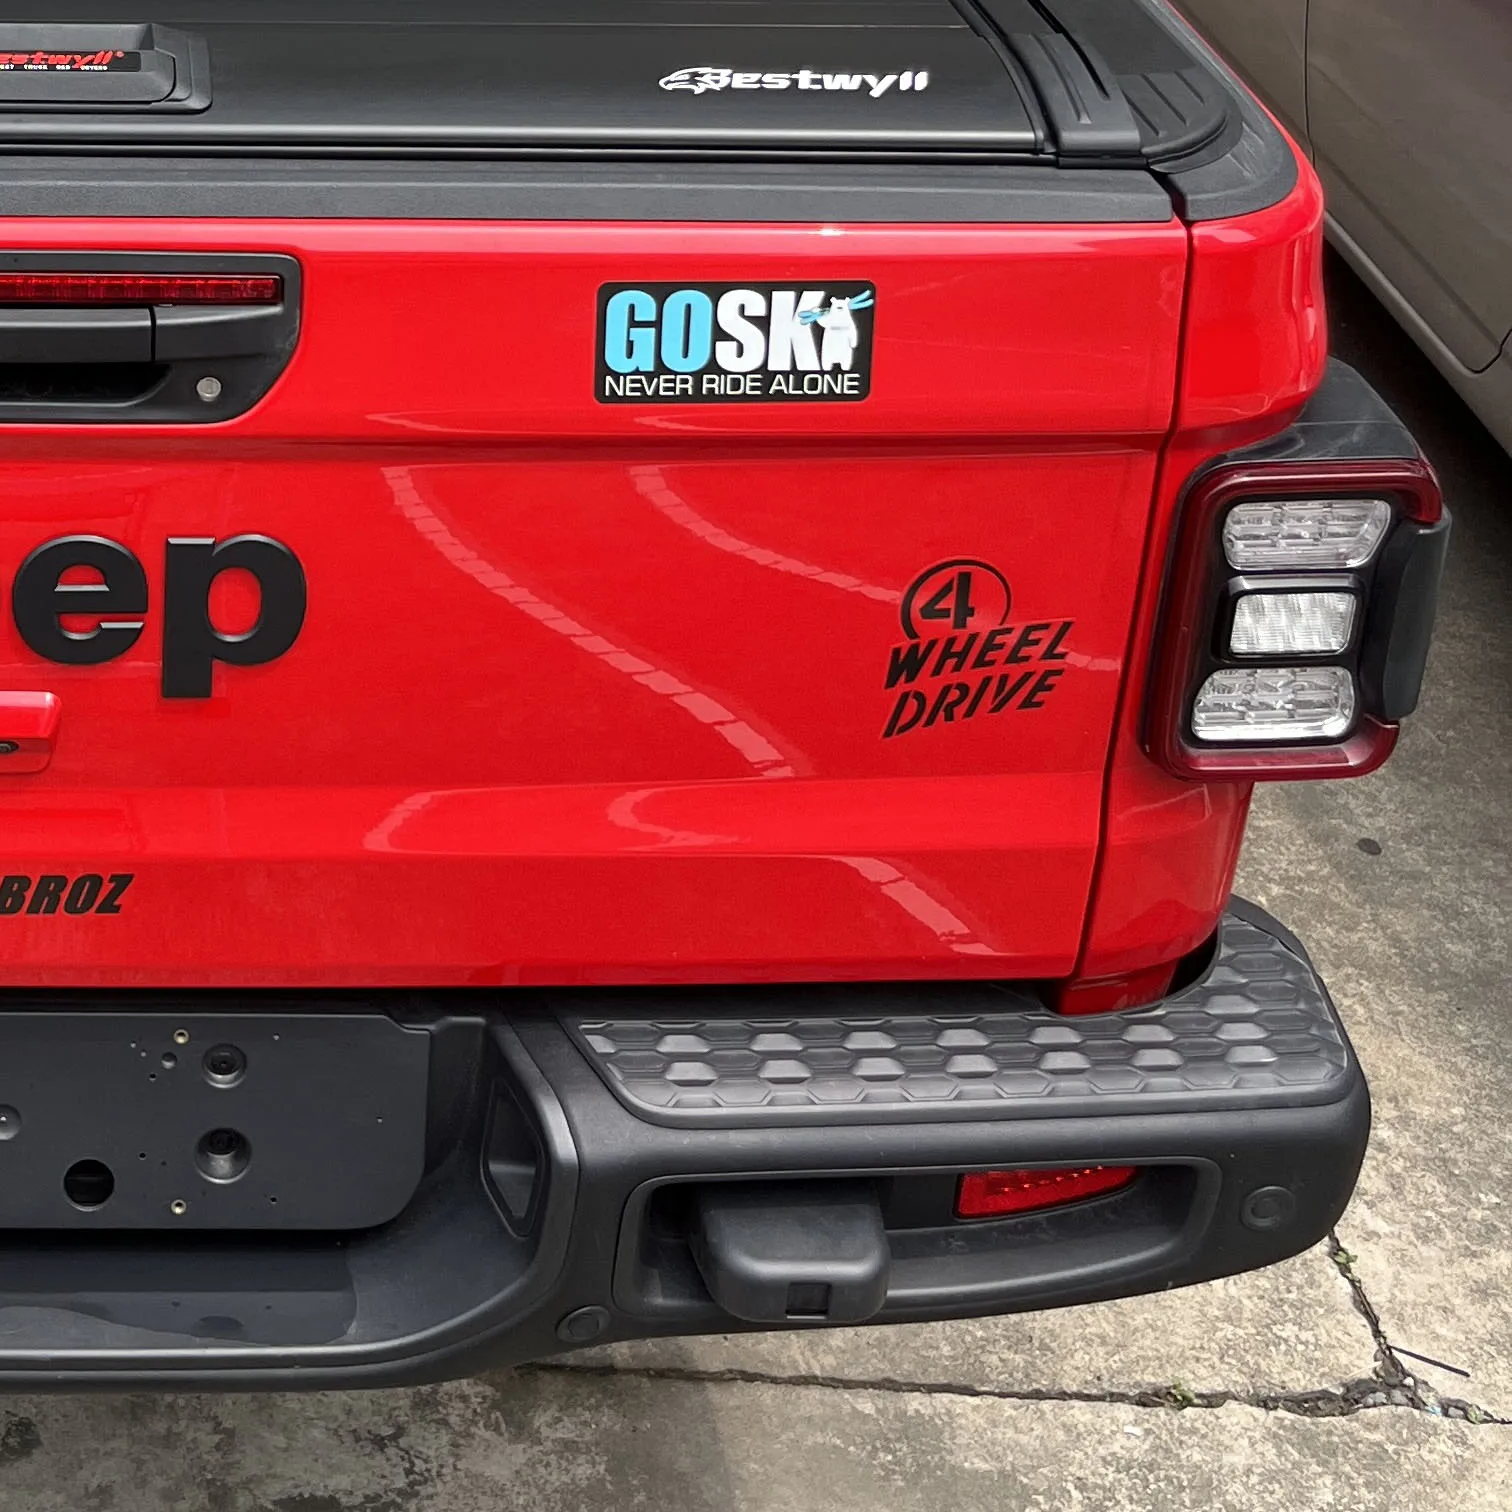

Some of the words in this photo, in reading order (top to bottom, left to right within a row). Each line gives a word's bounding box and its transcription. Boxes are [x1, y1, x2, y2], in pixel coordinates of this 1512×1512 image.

[604, 374, 693, 396] NEVER
[701, 374, 763, 395] RIDE
[768, 373, 861, 395] ALONE
[884, 620, 1075, 690] WHEEL
[881, 669, 1065, 739] DRIVE
